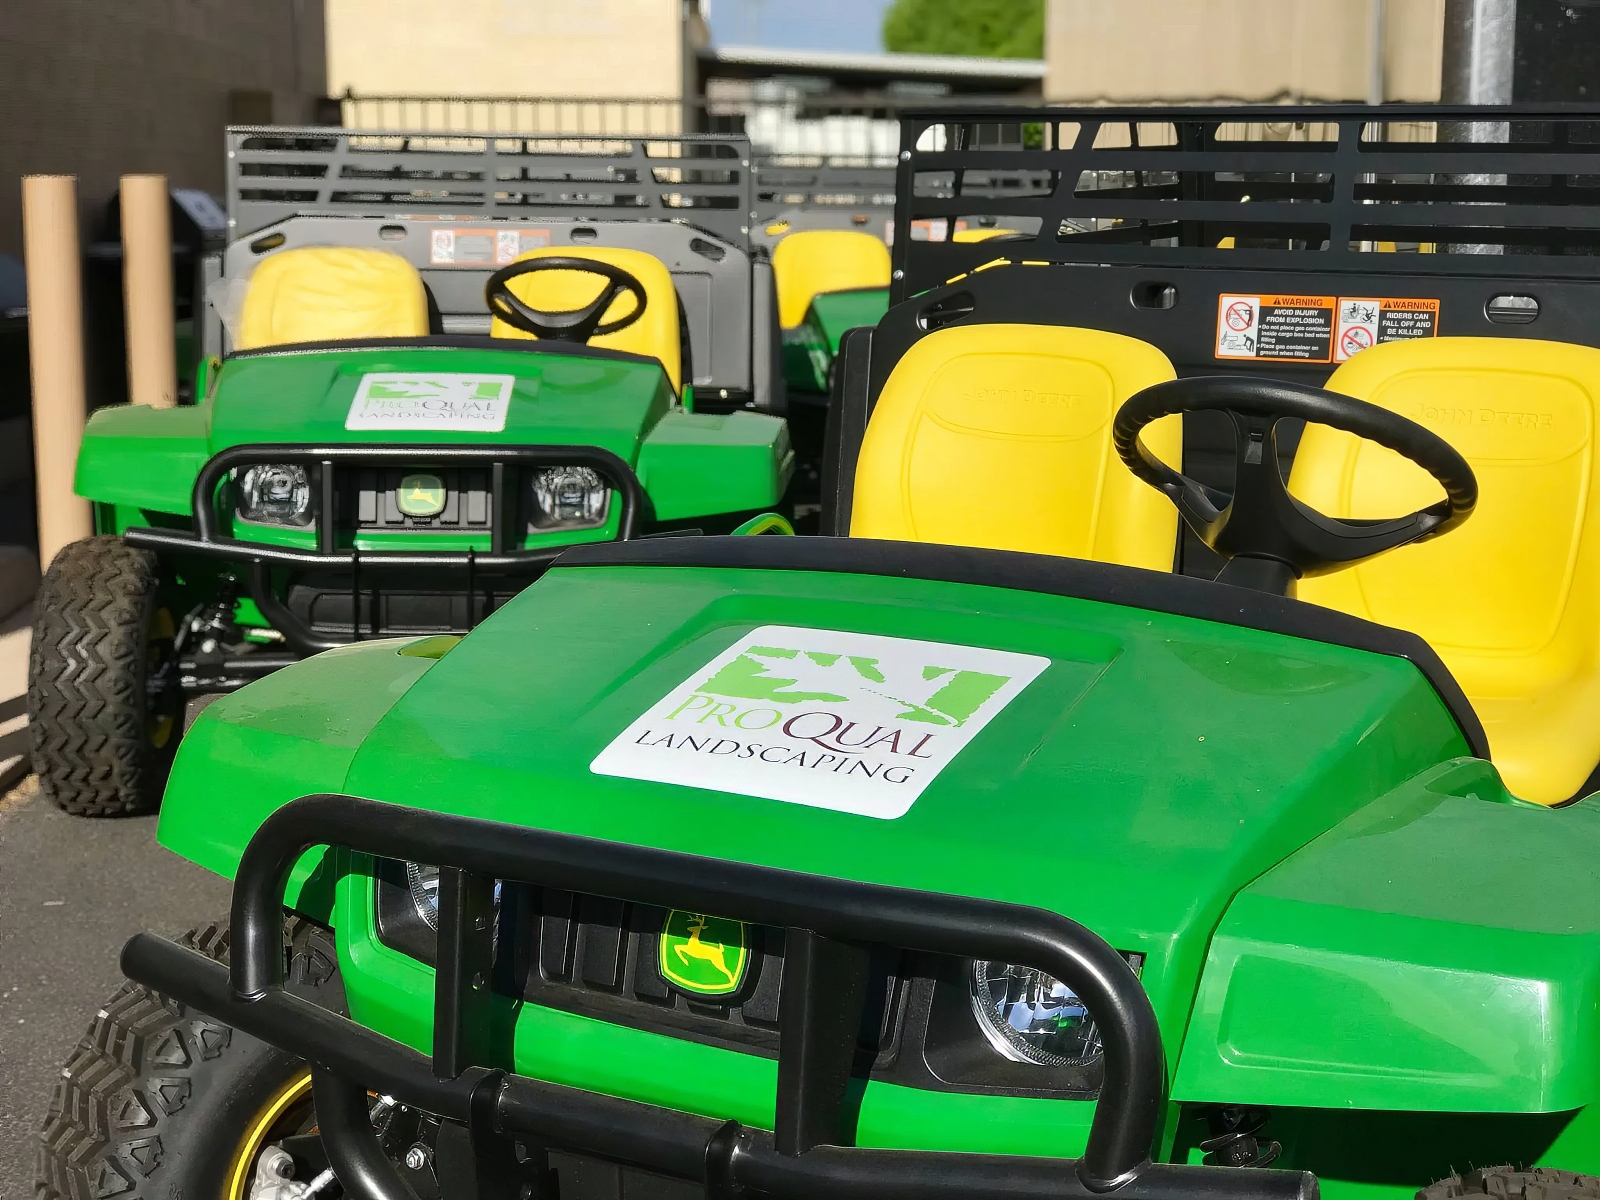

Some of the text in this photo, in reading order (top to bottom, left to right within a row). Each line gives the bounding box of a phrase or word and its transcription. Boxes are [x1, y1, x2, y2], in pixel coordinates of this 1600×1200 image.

[1281, 298, 1323, 307] WARNING
[1392, 301, 1436, 310] WARNING
[1273, 308, 1294, 316] AVOID
[1386, 312, 1413, 320] RIDERS
[1398, 328, 1423, 336] KILLED
[1409, 402, 1554, 431] JOHN DEERE
[633, 729, 917, 785] LANDSCAPING
